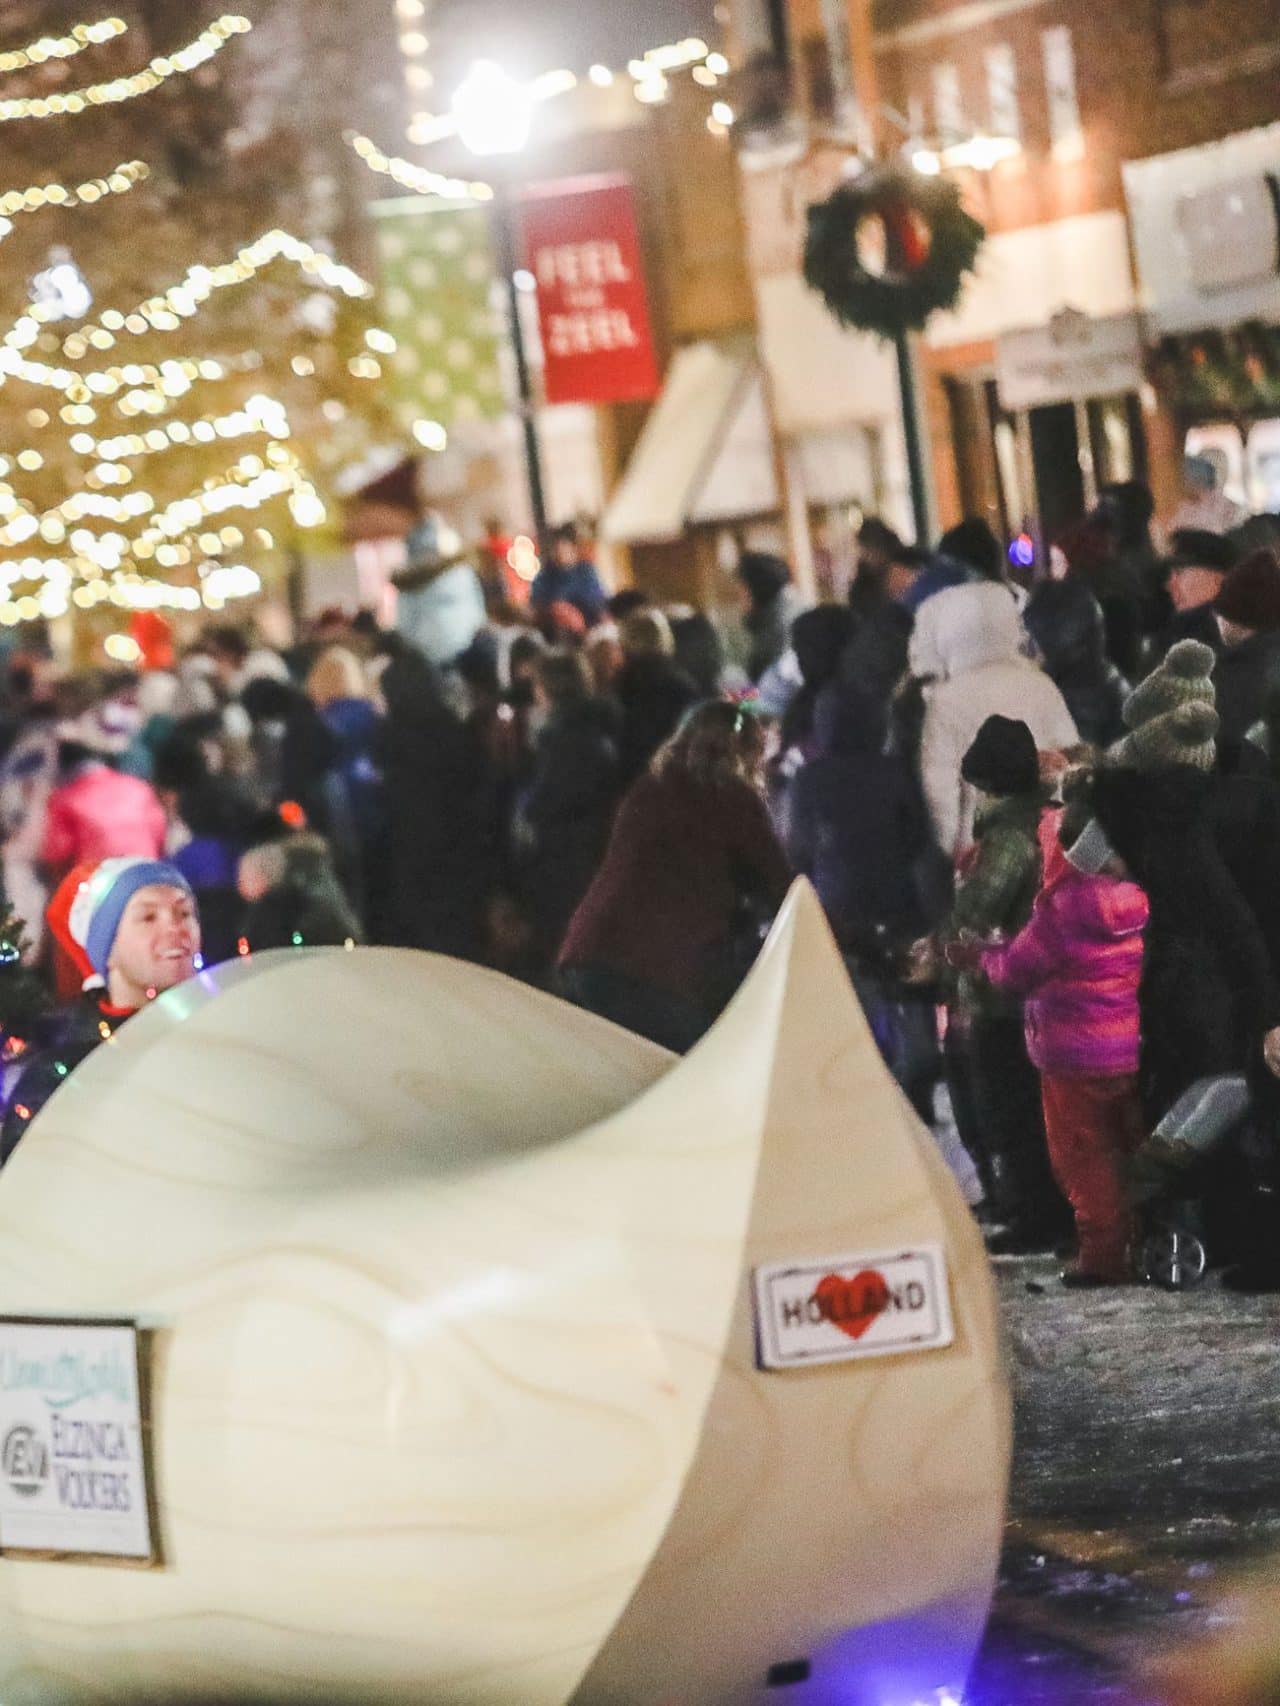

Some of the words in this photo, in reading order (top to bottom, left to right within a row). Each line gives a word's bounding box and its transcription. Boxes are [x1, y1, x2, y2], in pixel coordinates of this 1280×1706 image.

[535, 238, 631, 288] FEEL
[783, 1281, 926, 1328] HOLLAND
[51, 1413, 129, 1460] ELZINGA
